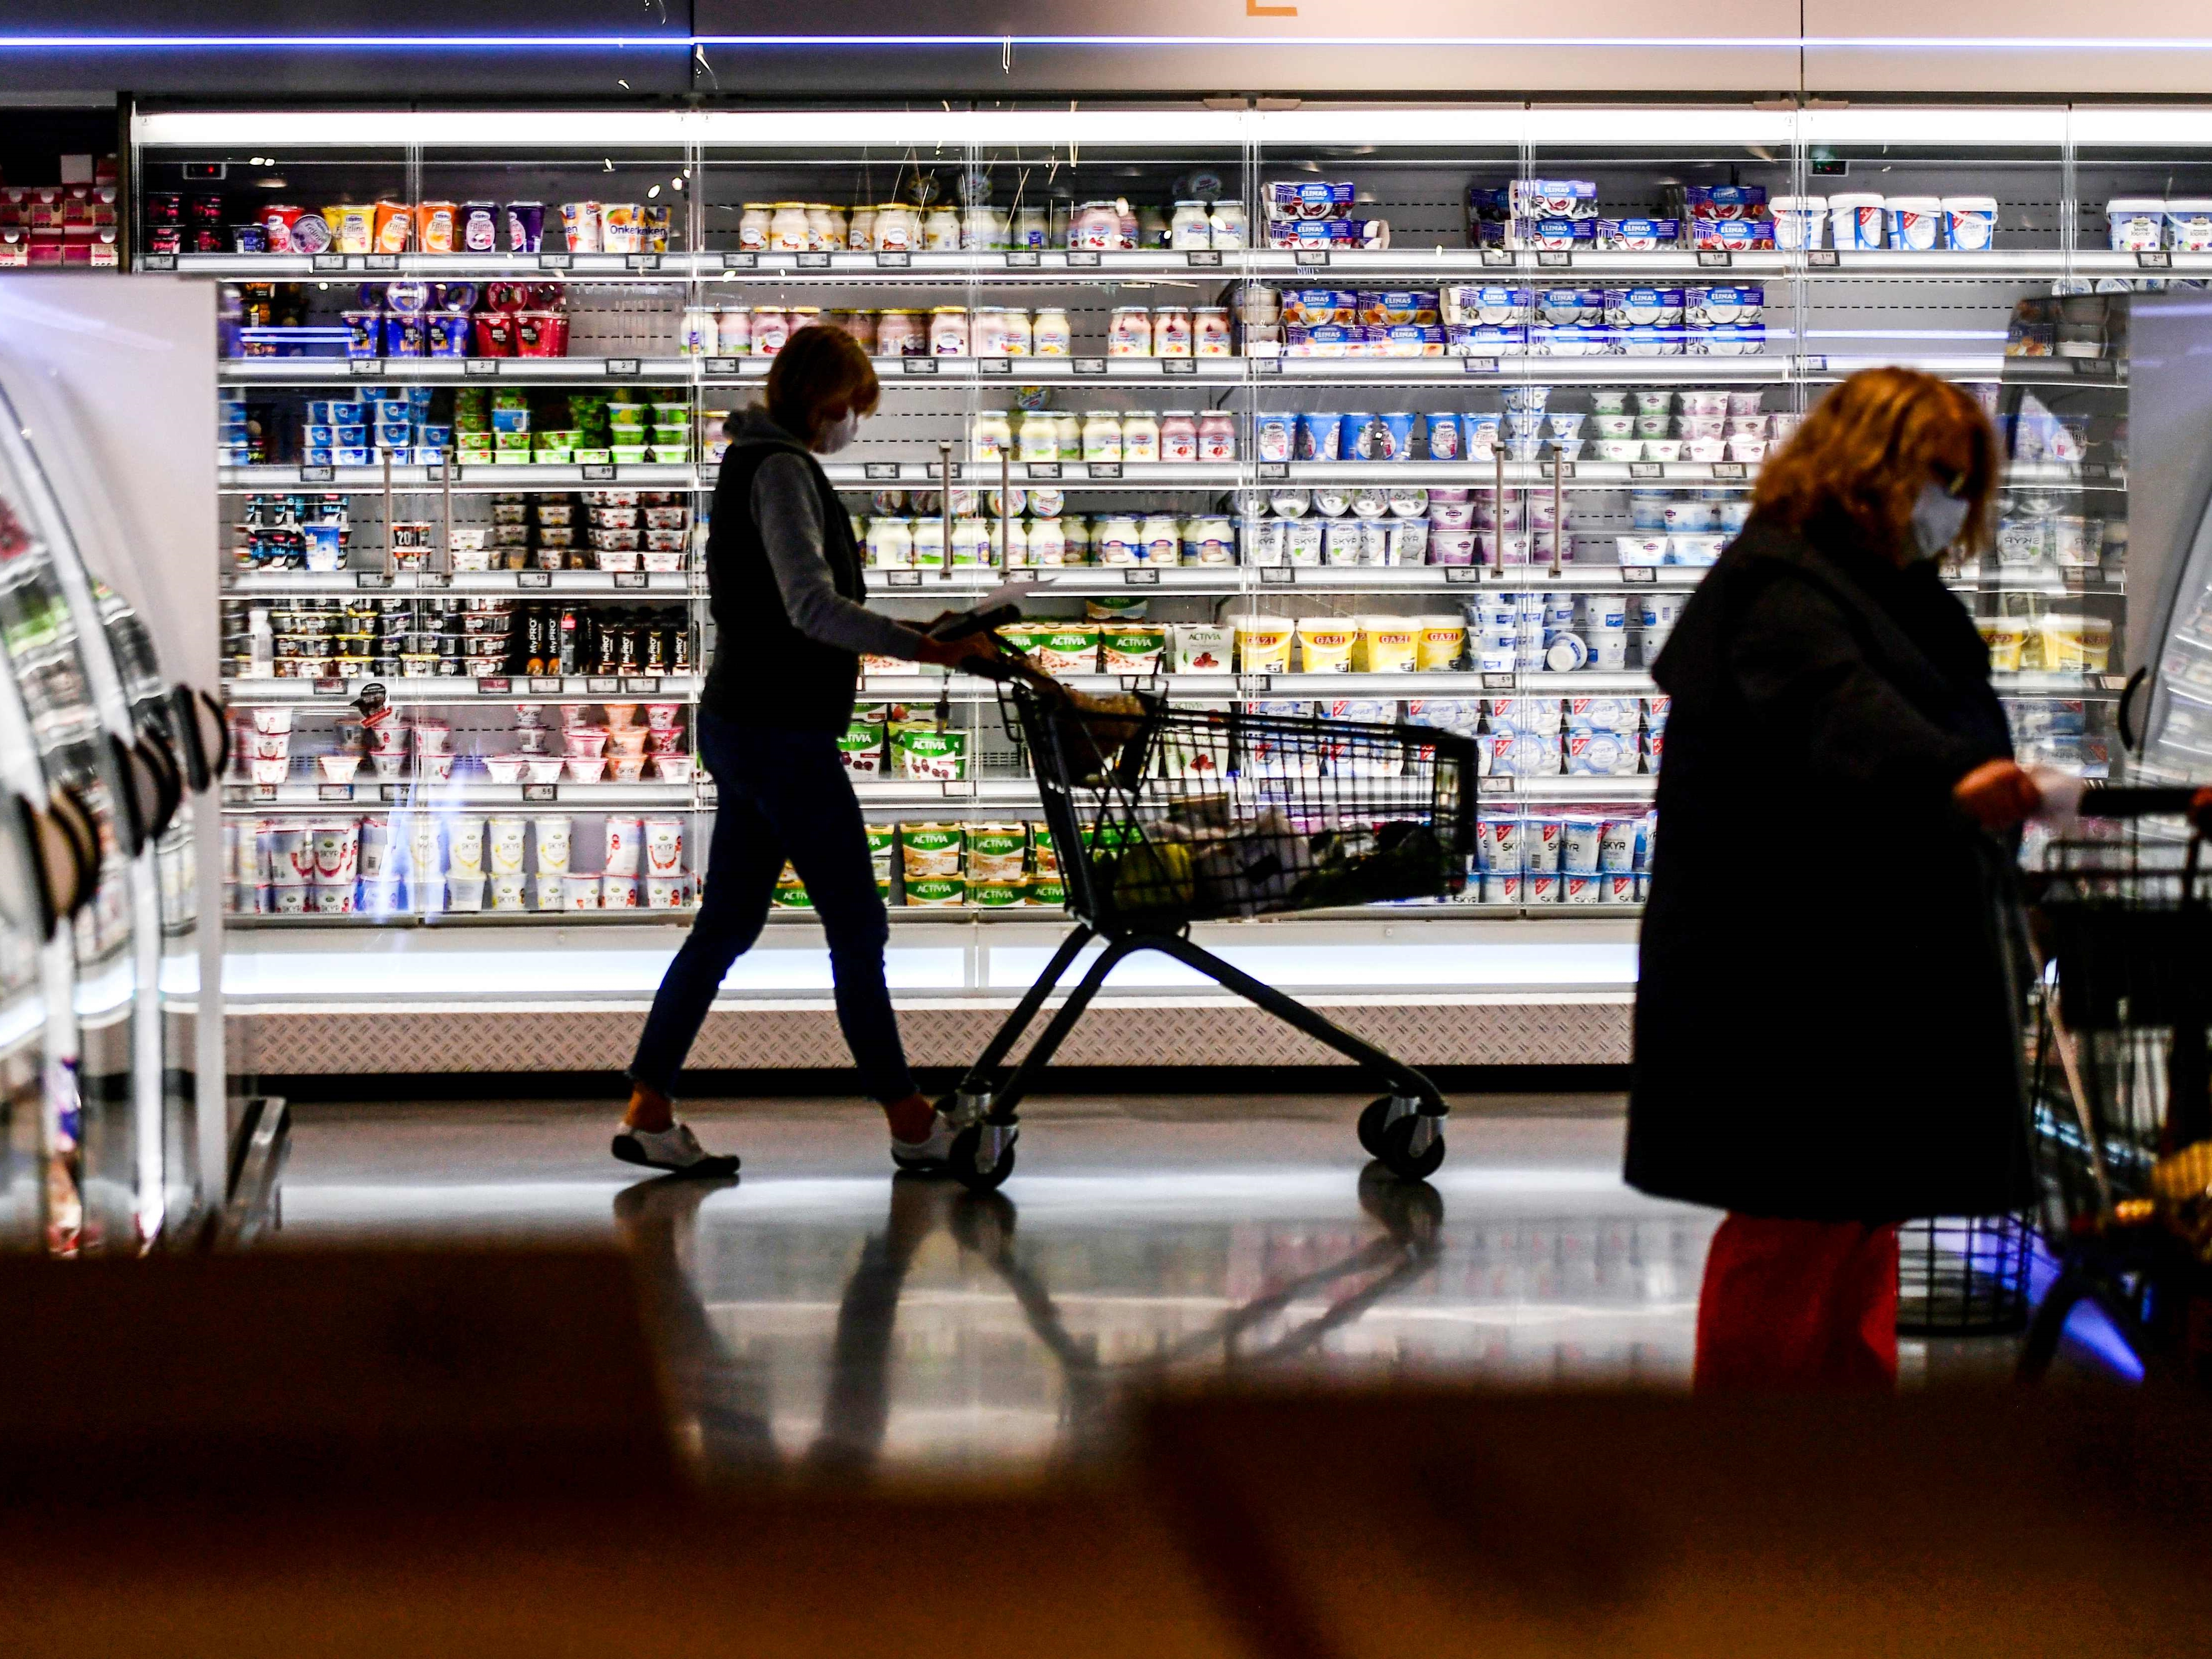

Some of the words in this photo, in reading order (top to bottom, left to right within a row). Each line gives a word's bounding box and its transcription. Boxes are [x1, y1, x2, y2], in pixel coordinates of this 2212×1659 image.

[1302, 189, 1328, 198] ELINAS
[1720, 226, 1747, 234] ELINAS
[398, 531, 411, 546] 20
[1050, 637, 1086, 646] ACTIVIA
[1116, 638, 1151, 647] ACTIVIA
[913, 741, 946, 750] ACTIVIA
[913, 835, 948, 844] ACTIVIA
[979, 839, 1013, 848] ACTIVIA
[1603, 841, 1626, 850] SKYR
[917, 885, 951, 894] ACTIVIA
[978, 890, 1013, 899] ACTIVIA
